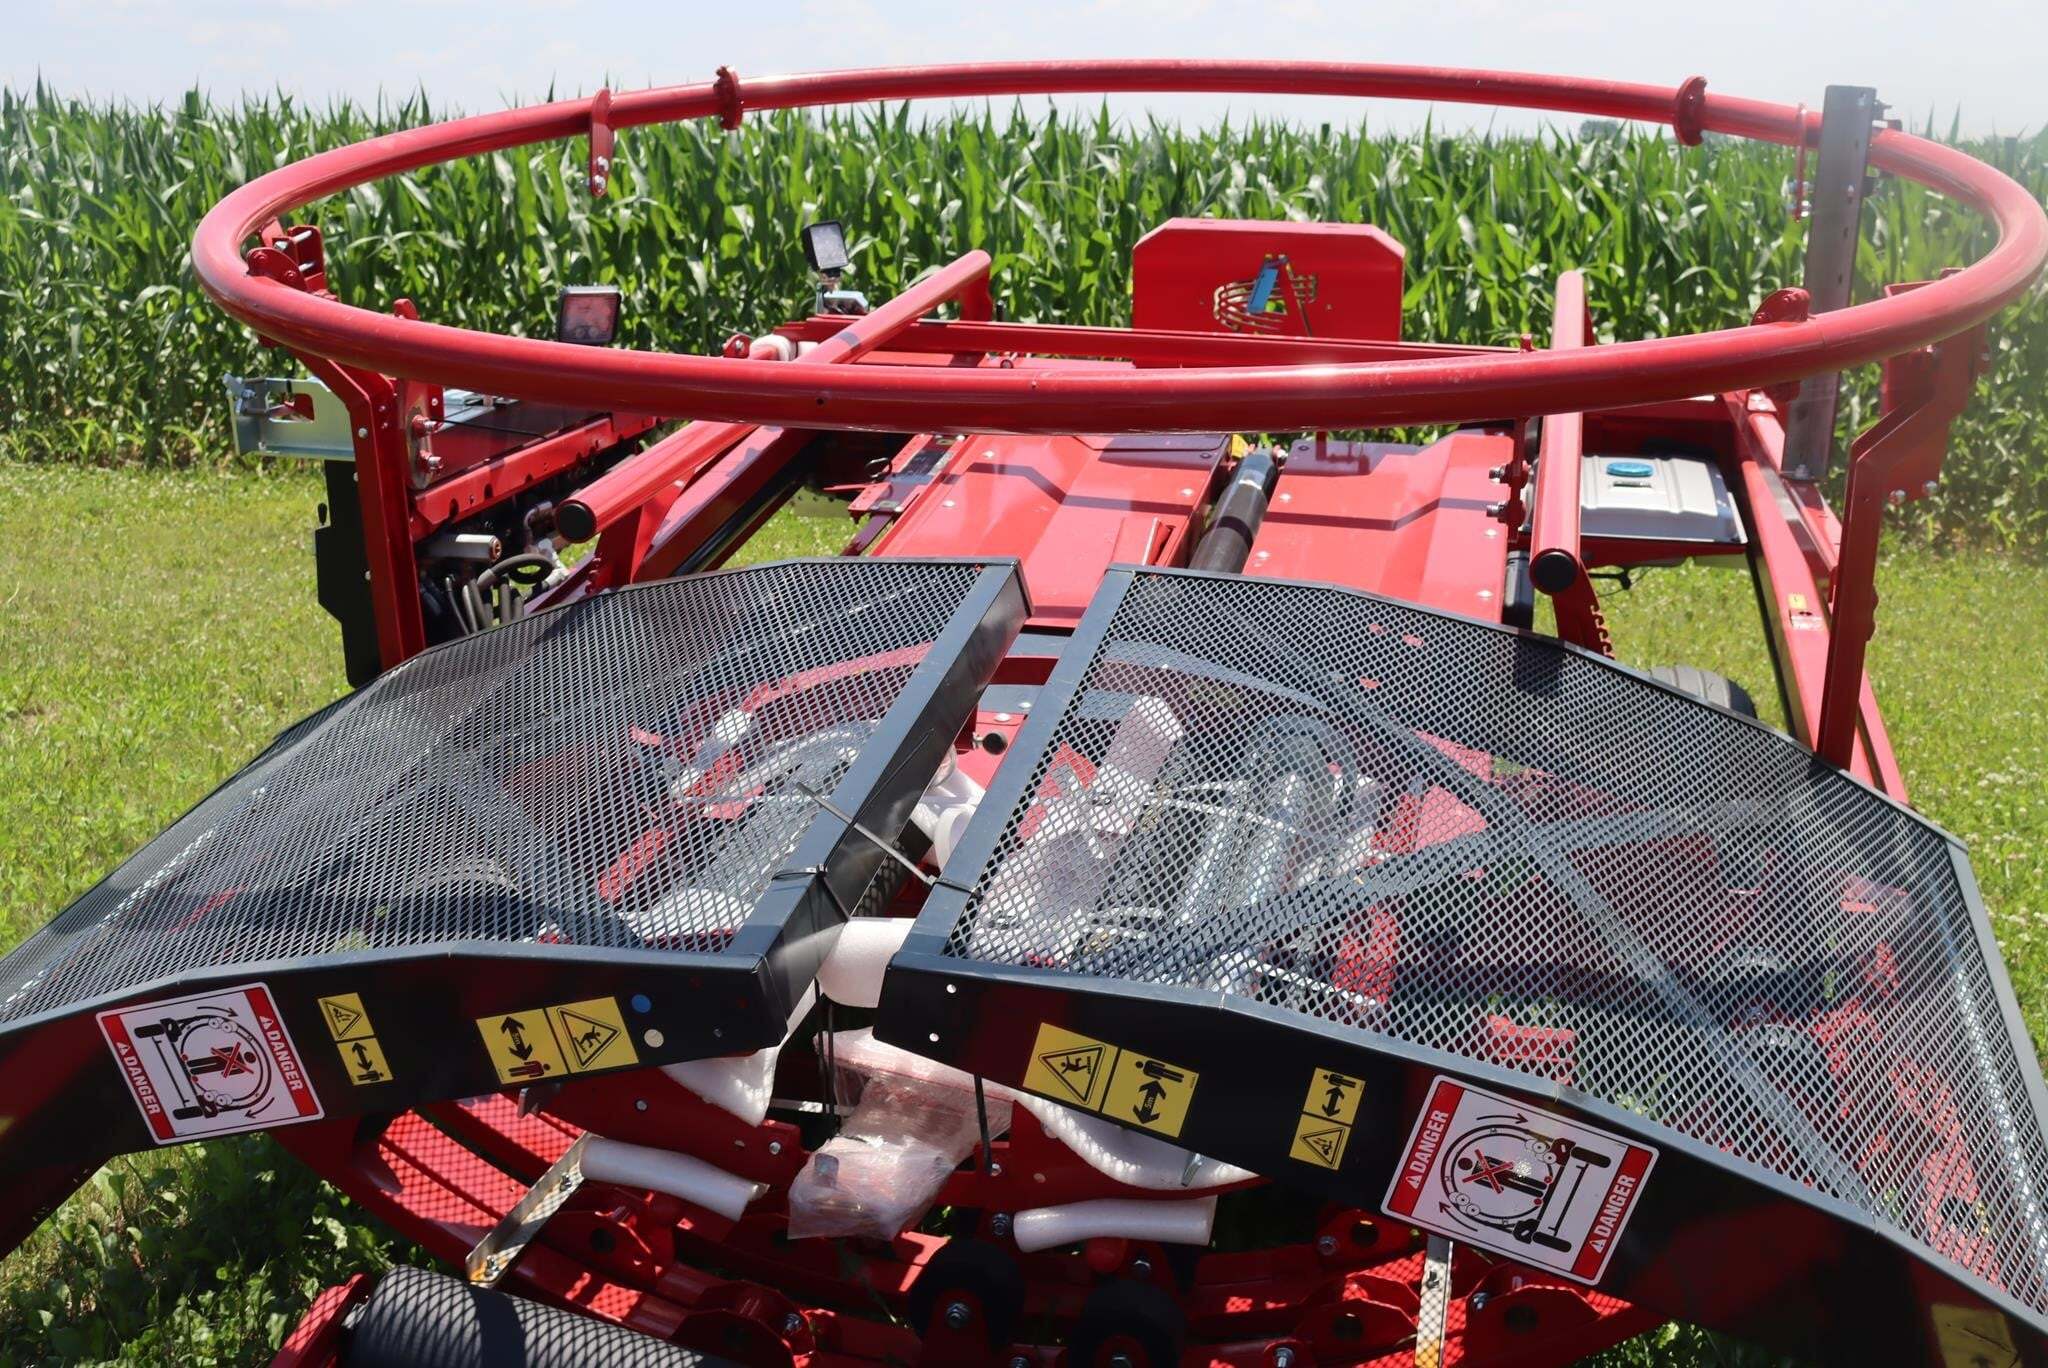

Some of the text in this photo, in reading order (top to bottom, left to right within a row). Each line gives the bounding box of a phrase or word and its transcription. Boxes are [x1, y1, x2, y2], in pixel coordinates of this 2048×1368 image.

[124, 1056, 161, 1115] DANGER
[268, 1030, 303, 1090] DANGER
[1417, 1108, 1449, 1173] DANGER
[1597, 1174, 1636, 1237] DANGER
